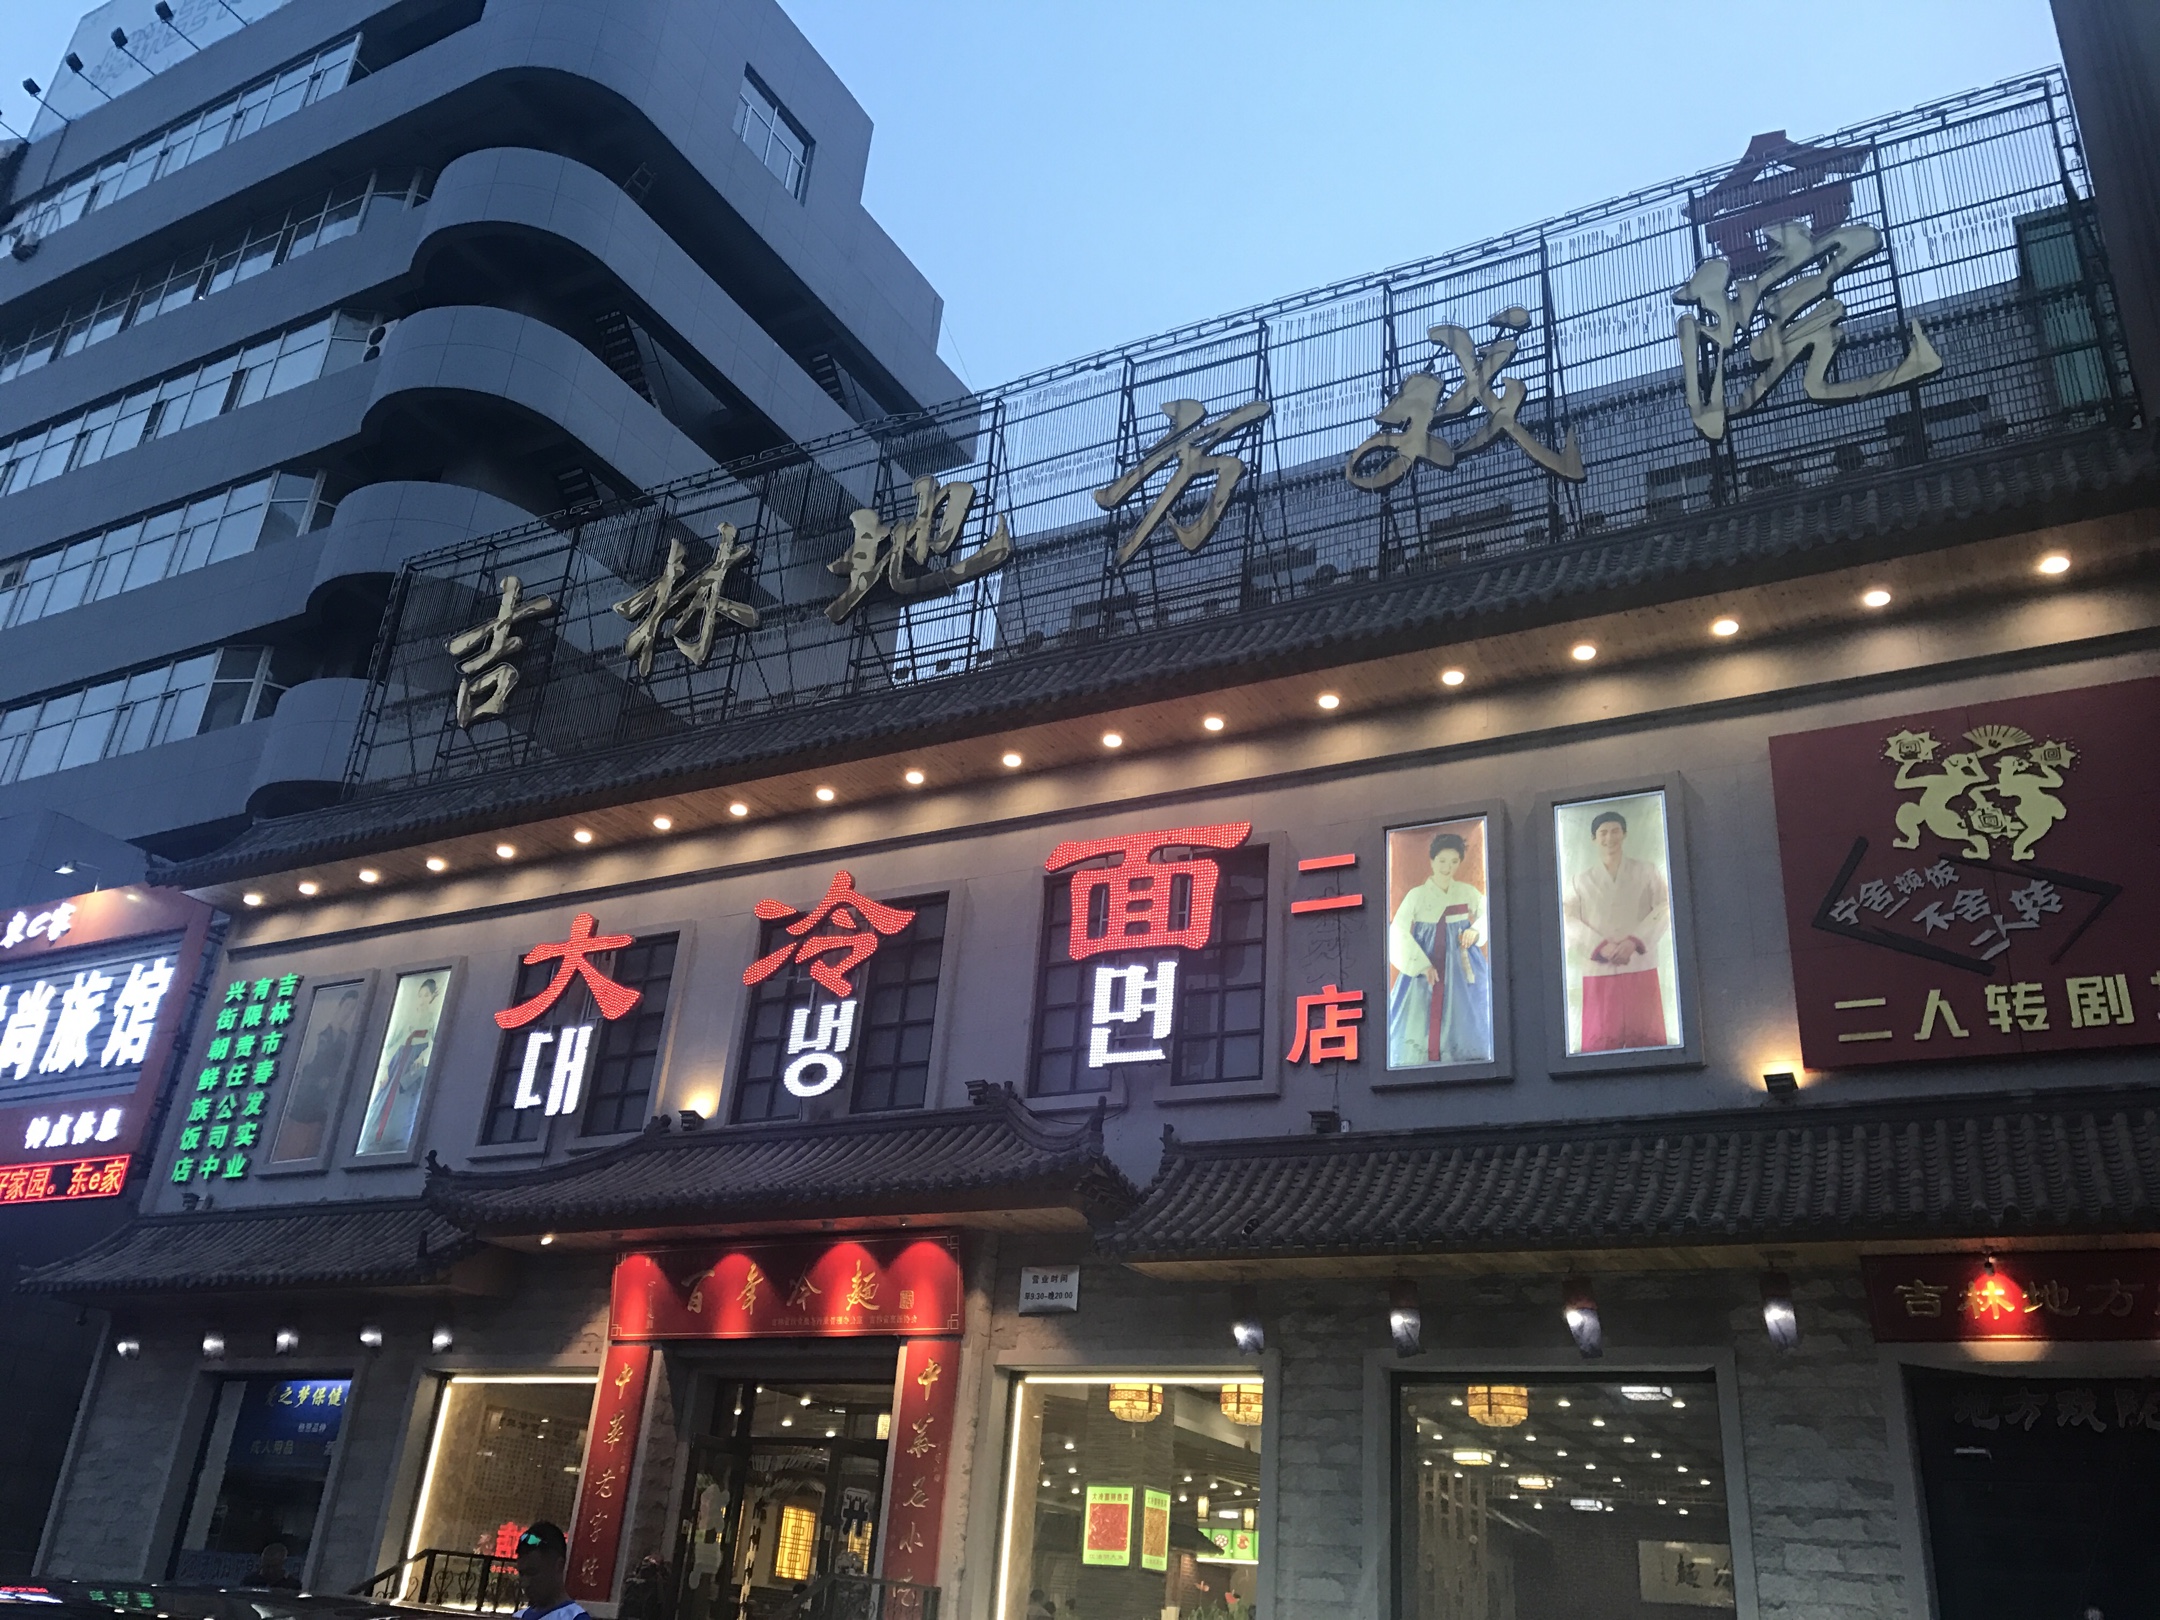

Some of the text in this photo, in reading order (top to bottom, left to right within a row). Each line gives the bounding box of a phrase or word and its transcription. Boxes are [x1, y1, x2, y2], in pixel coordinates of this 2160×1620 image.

[1829, 859, 1960, 926] 宁舍一顿饭
[1286, 853, 1364, 1065] 二店
[1835, 971, 2160, 1042] 二人转剧
[0, 957, 175, 1081] 尚旅馆
[171, 980, 247, 1183] 兴街朝鲜族饭店
[199, 977, 274, 1180] 有限责任公司中
[222, 973, 299, 1179] 吉林市春发实业
[1032, 1274, 1069, 1285] 营业时间
[1894, 1278, 2160, 1320] 吉林地方
[265, 1384, 348, 1409] 之梦保健
